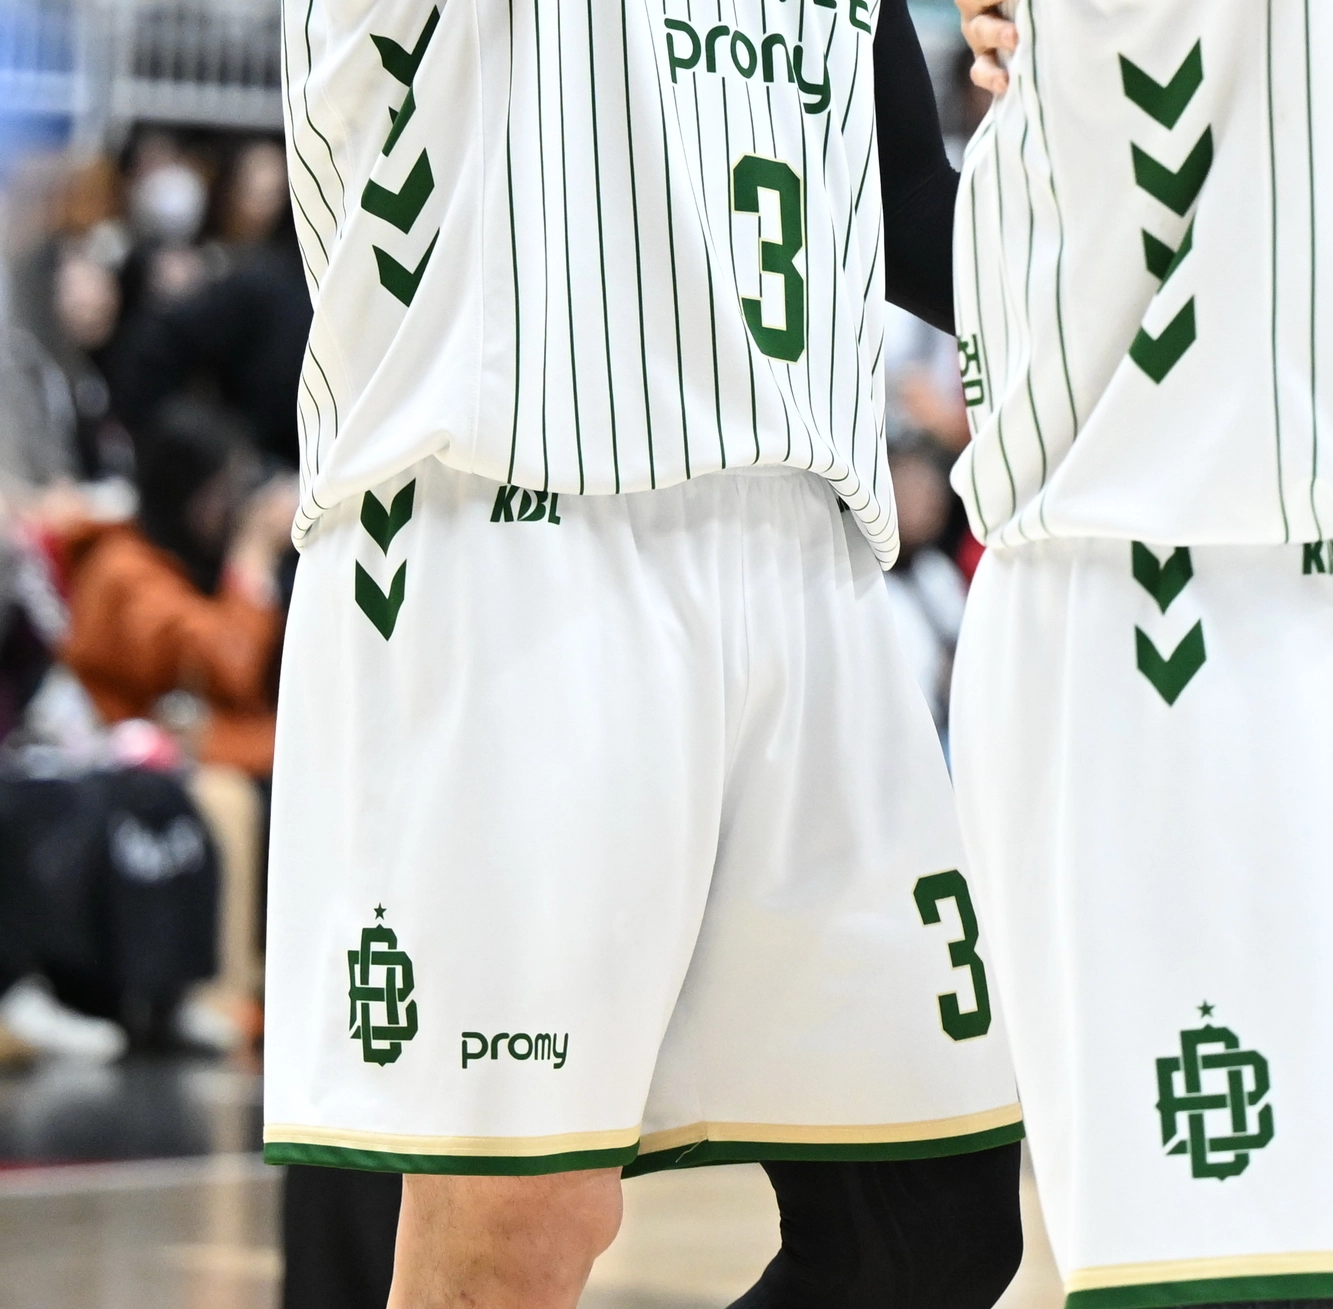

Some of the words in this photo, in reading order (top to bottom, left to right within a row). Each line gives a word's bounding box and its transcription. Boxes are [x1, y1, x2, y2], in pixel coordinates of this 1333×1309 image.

[730, 153, 806, 365] 3
[490, 484, 561, 525] KBL
[912, 868, 993, 1043] 3
[460, 1030, 570, 1071] promy
